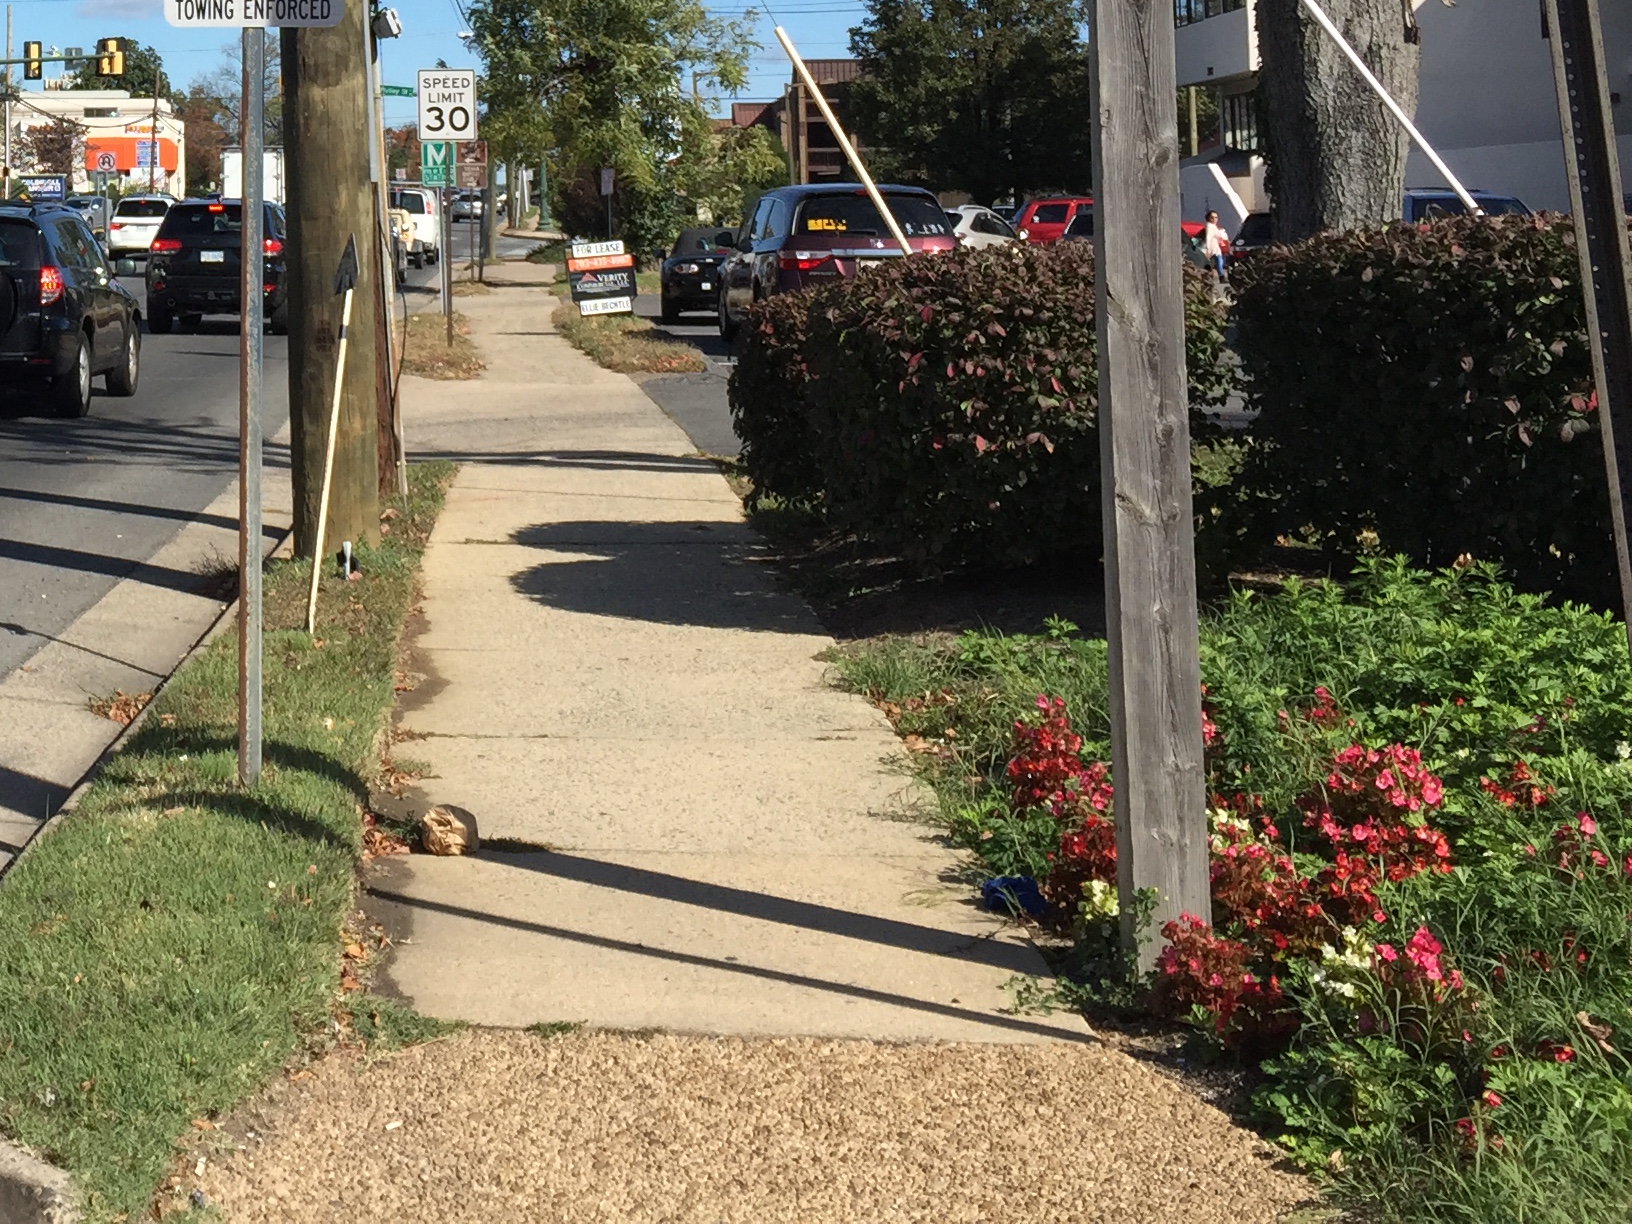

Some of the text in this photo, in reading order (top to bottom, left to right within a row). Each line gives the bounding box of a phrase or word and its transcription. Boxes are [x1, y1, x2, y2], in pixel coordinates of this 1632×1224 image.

[423, 77, 471, 89] SPEED
[428, 92, 465, 104] LIMIT
[425, 106, 470, 132] 30
[576, 243, 621, 255] FOR LEASE
[596, 272, 629, 282] VERITY
